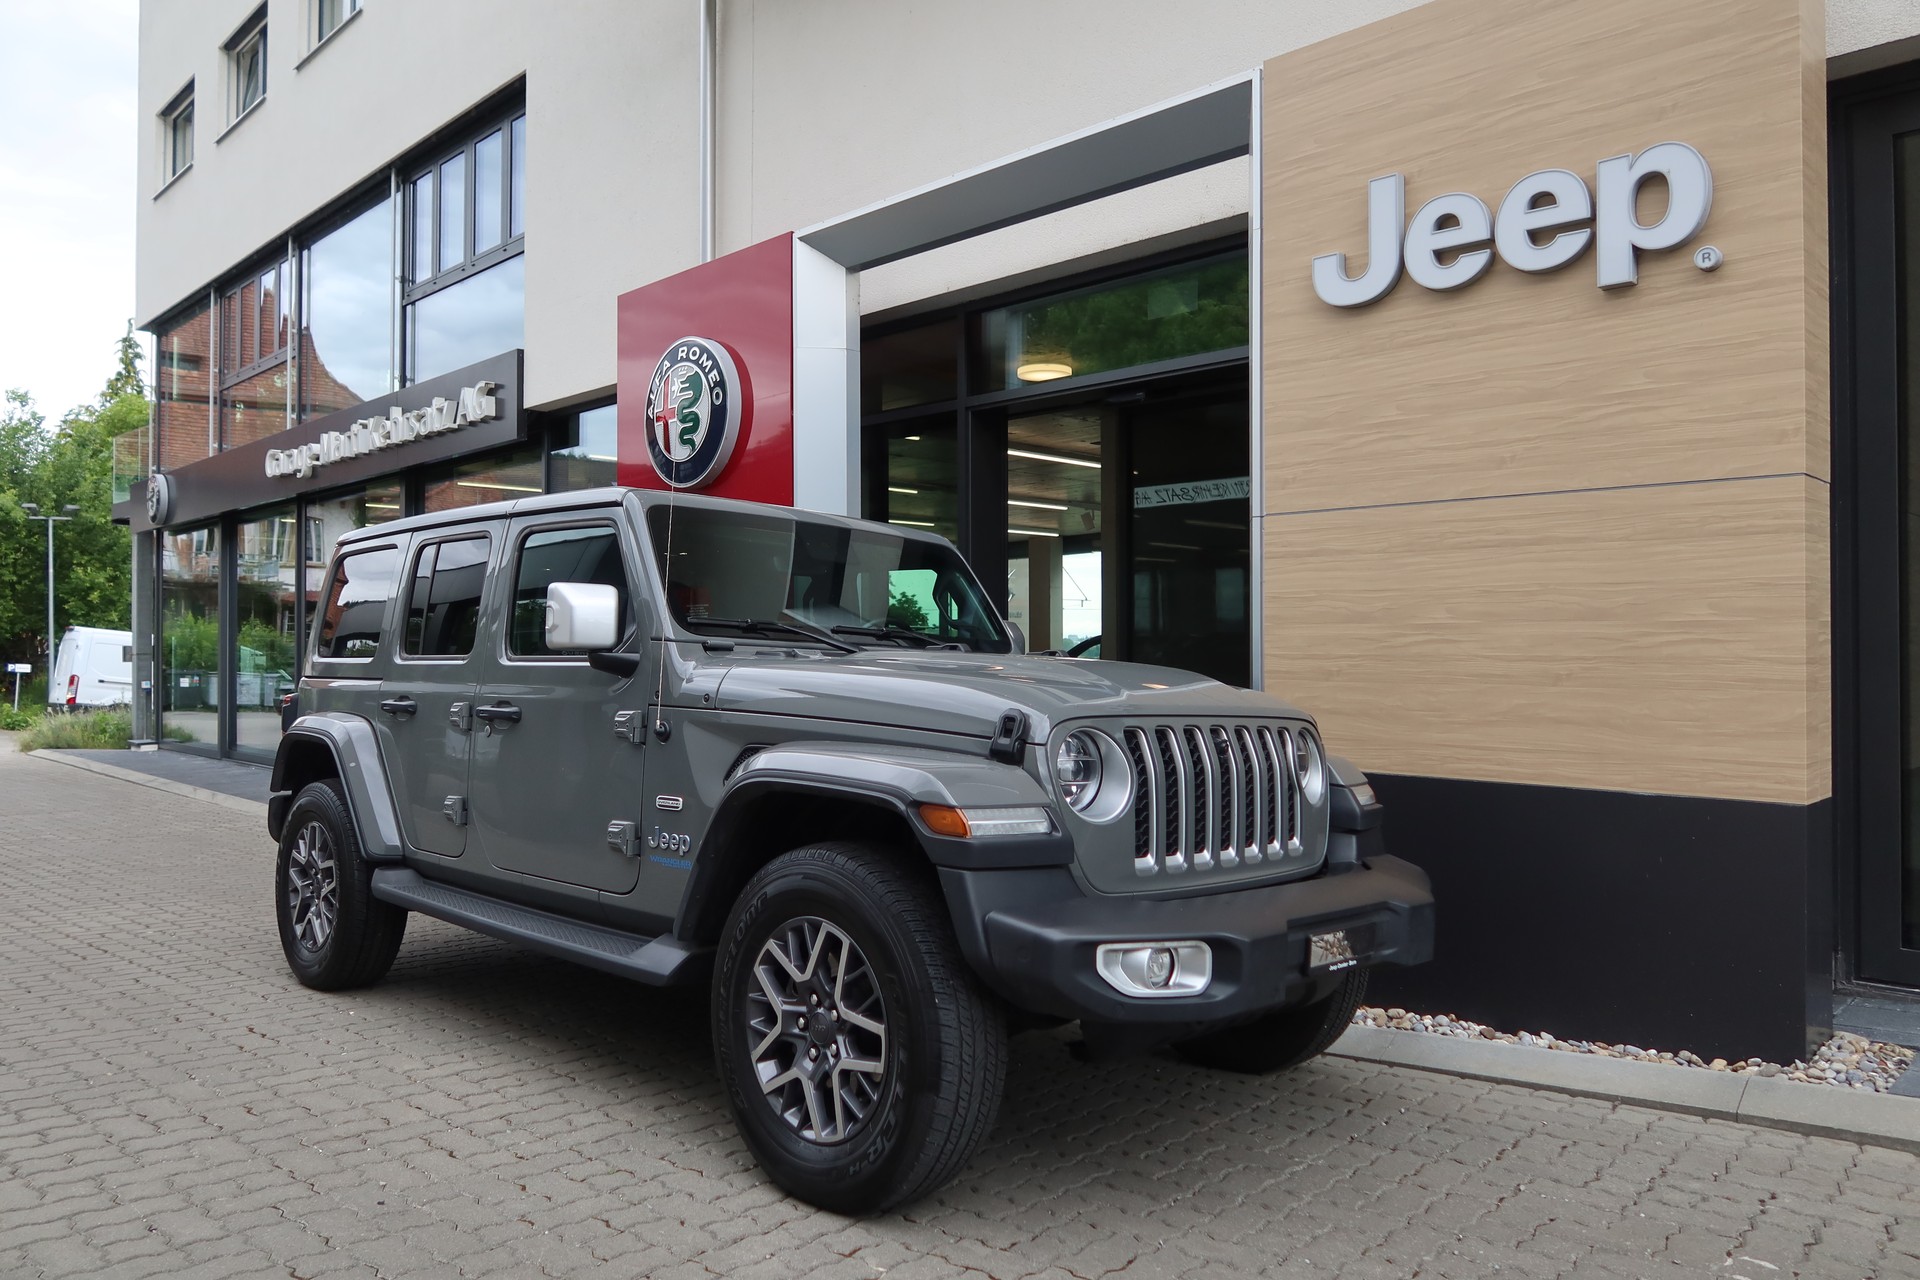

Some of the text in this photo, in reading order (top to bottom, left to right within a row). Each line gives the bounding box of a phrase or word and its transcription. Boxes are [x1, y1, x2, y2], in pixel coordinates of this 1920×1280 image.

[1311, 140, 1714, 309] Jeep
[647, 346, 723, 420] ALFA ROMEO
[265, 443, 321, 479] Garage
[456, 381, 496, 426] AG
[647, 826, 690, 856] Jeep
